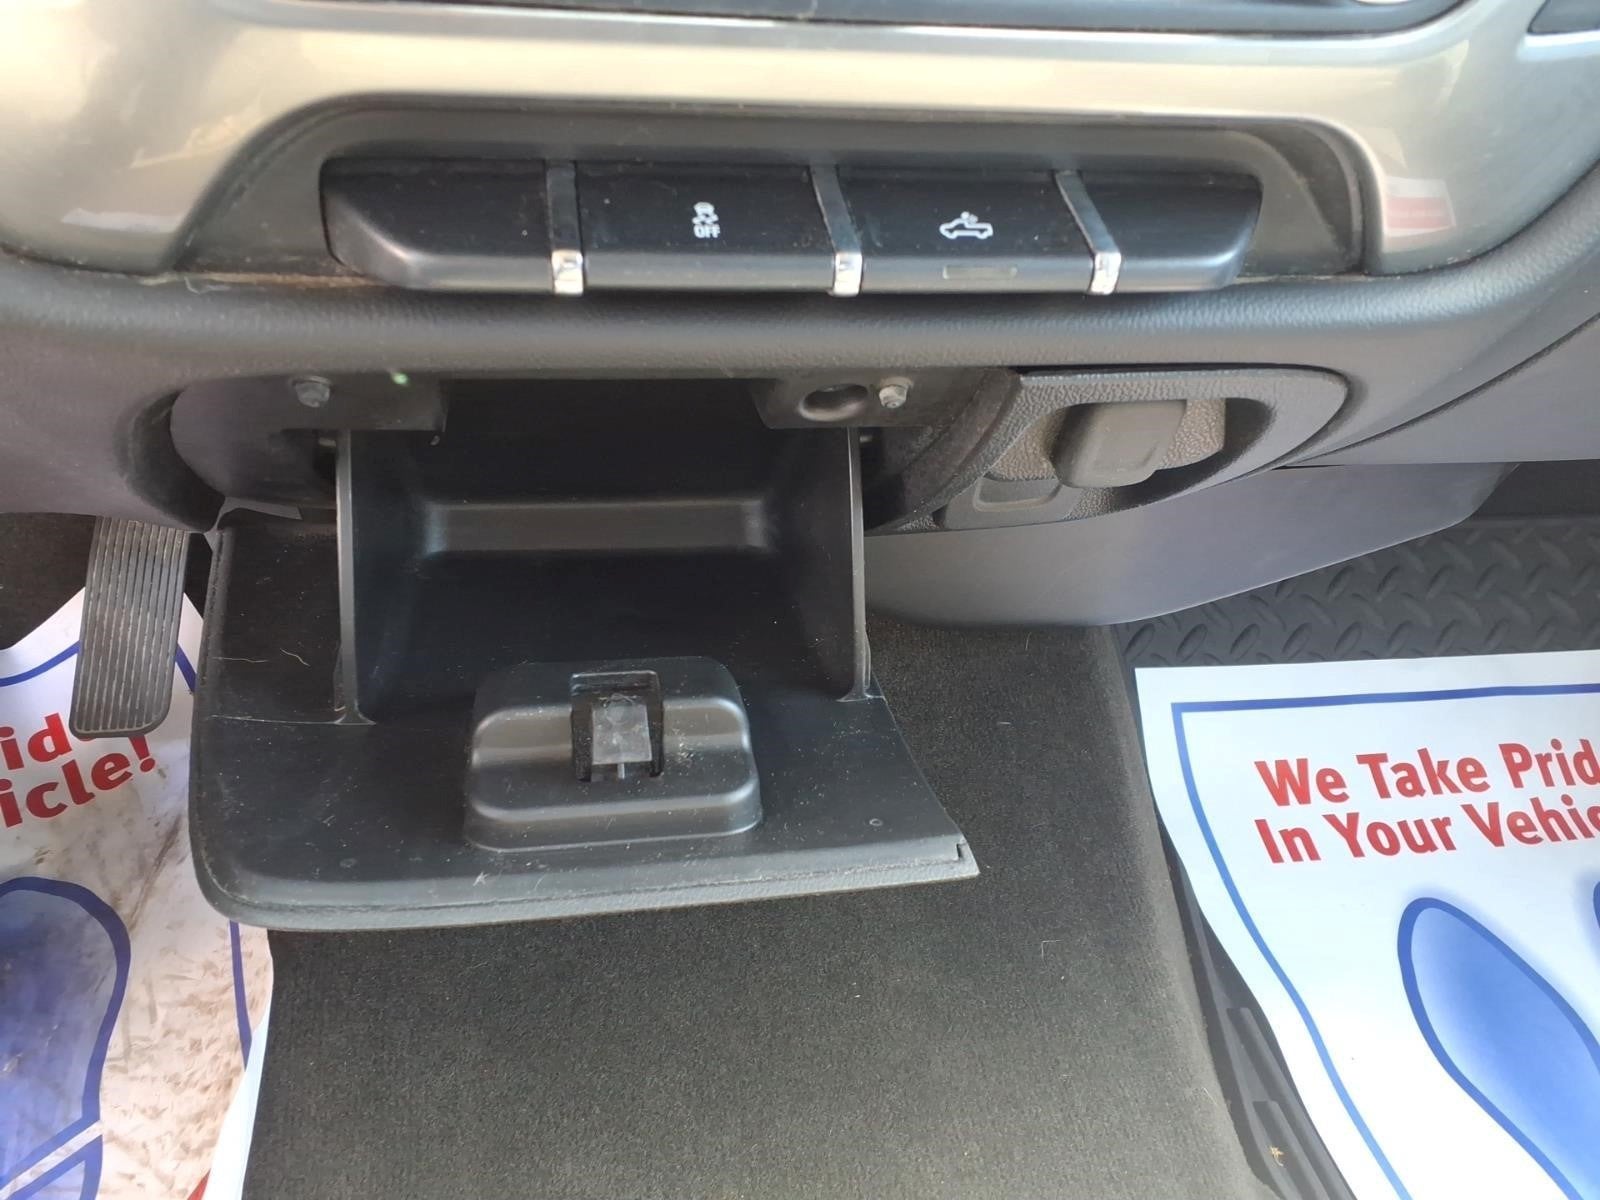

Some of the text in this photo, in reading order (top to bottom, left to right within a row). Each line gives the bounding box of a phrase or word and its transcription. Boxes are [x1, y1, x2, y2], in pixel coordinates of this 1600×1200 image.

[693, 223, 721, 239] OFF
[0, 712, 78, 770] id
[1254, 757, 1350, 807] We
[1356, 747, 1491, 799] Take
[1254, 817, 1322, 864] In
[1322, 811, 1457, 858] Your
